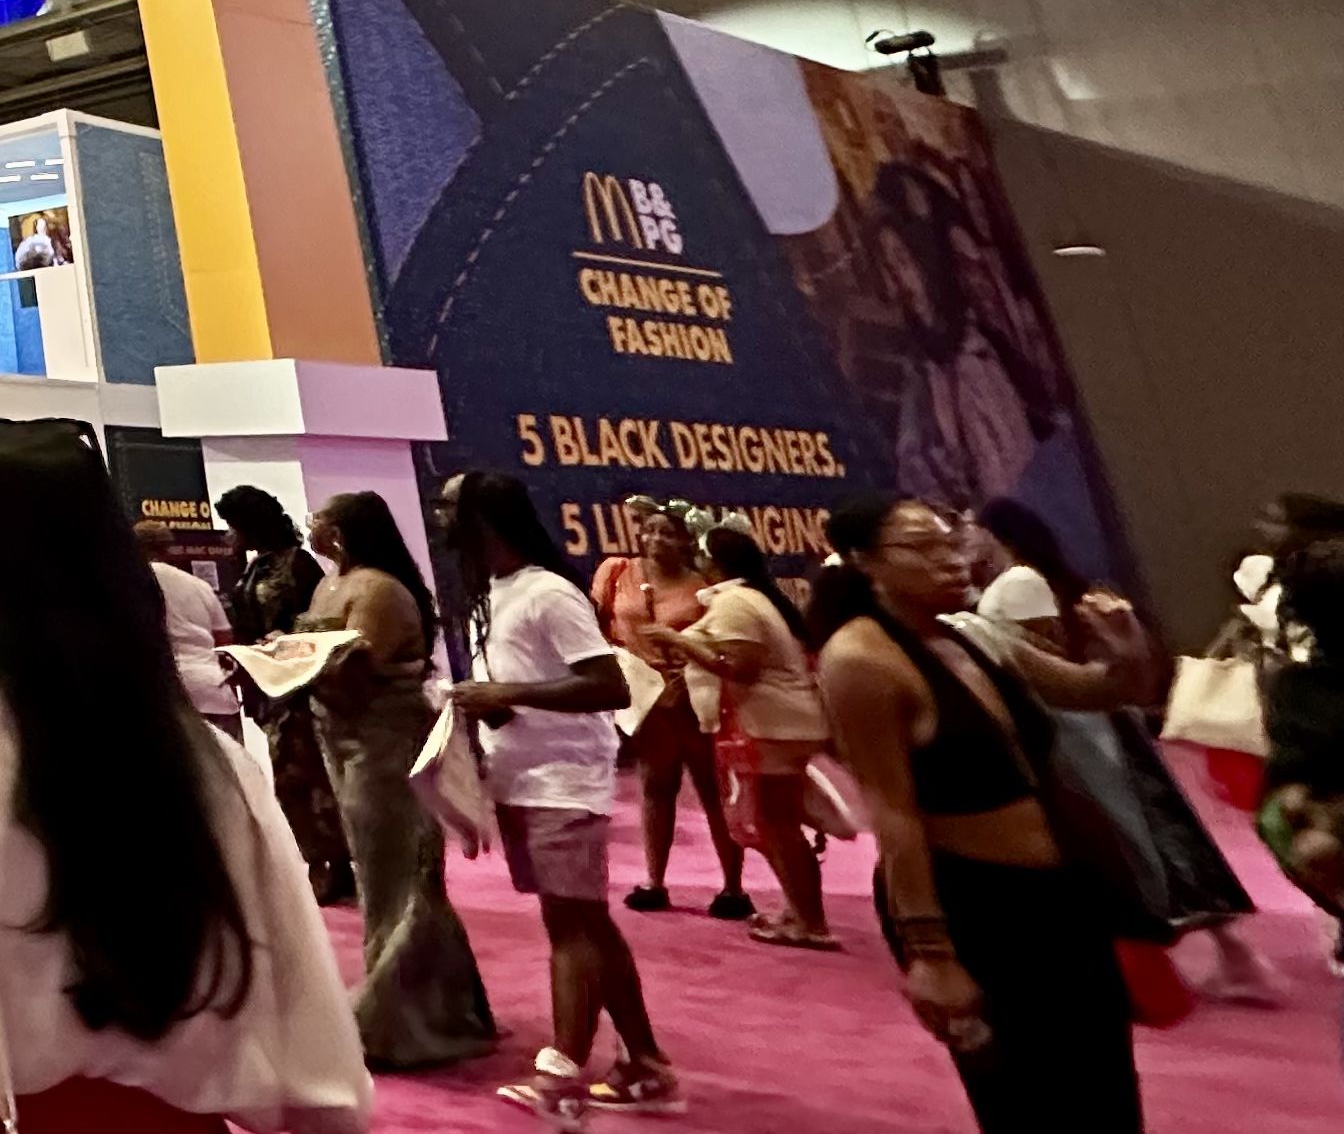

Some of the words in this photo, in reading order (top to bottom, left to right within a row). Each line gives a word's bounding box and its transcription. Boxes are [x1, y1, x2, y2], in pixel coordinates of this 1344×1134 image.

[628, 178, 676, 219] B&
[638, 214, 684, 255] PG
[579, 267, 697, 316] CHANGE
[697, 284, 733, 321] OF
[607, 315, 734, 365] FASHION
[517, 414, 545, 466] 5
[549, 415, 672, 469] BLACK
[670, 420, 846, 478] DESIGNERS.
[141, 499, 198, 518] CHANGE
[199, 502, 210, 519] O
[560, 502, 589, 556] 5
[592, 503, 640, 554] LIF
